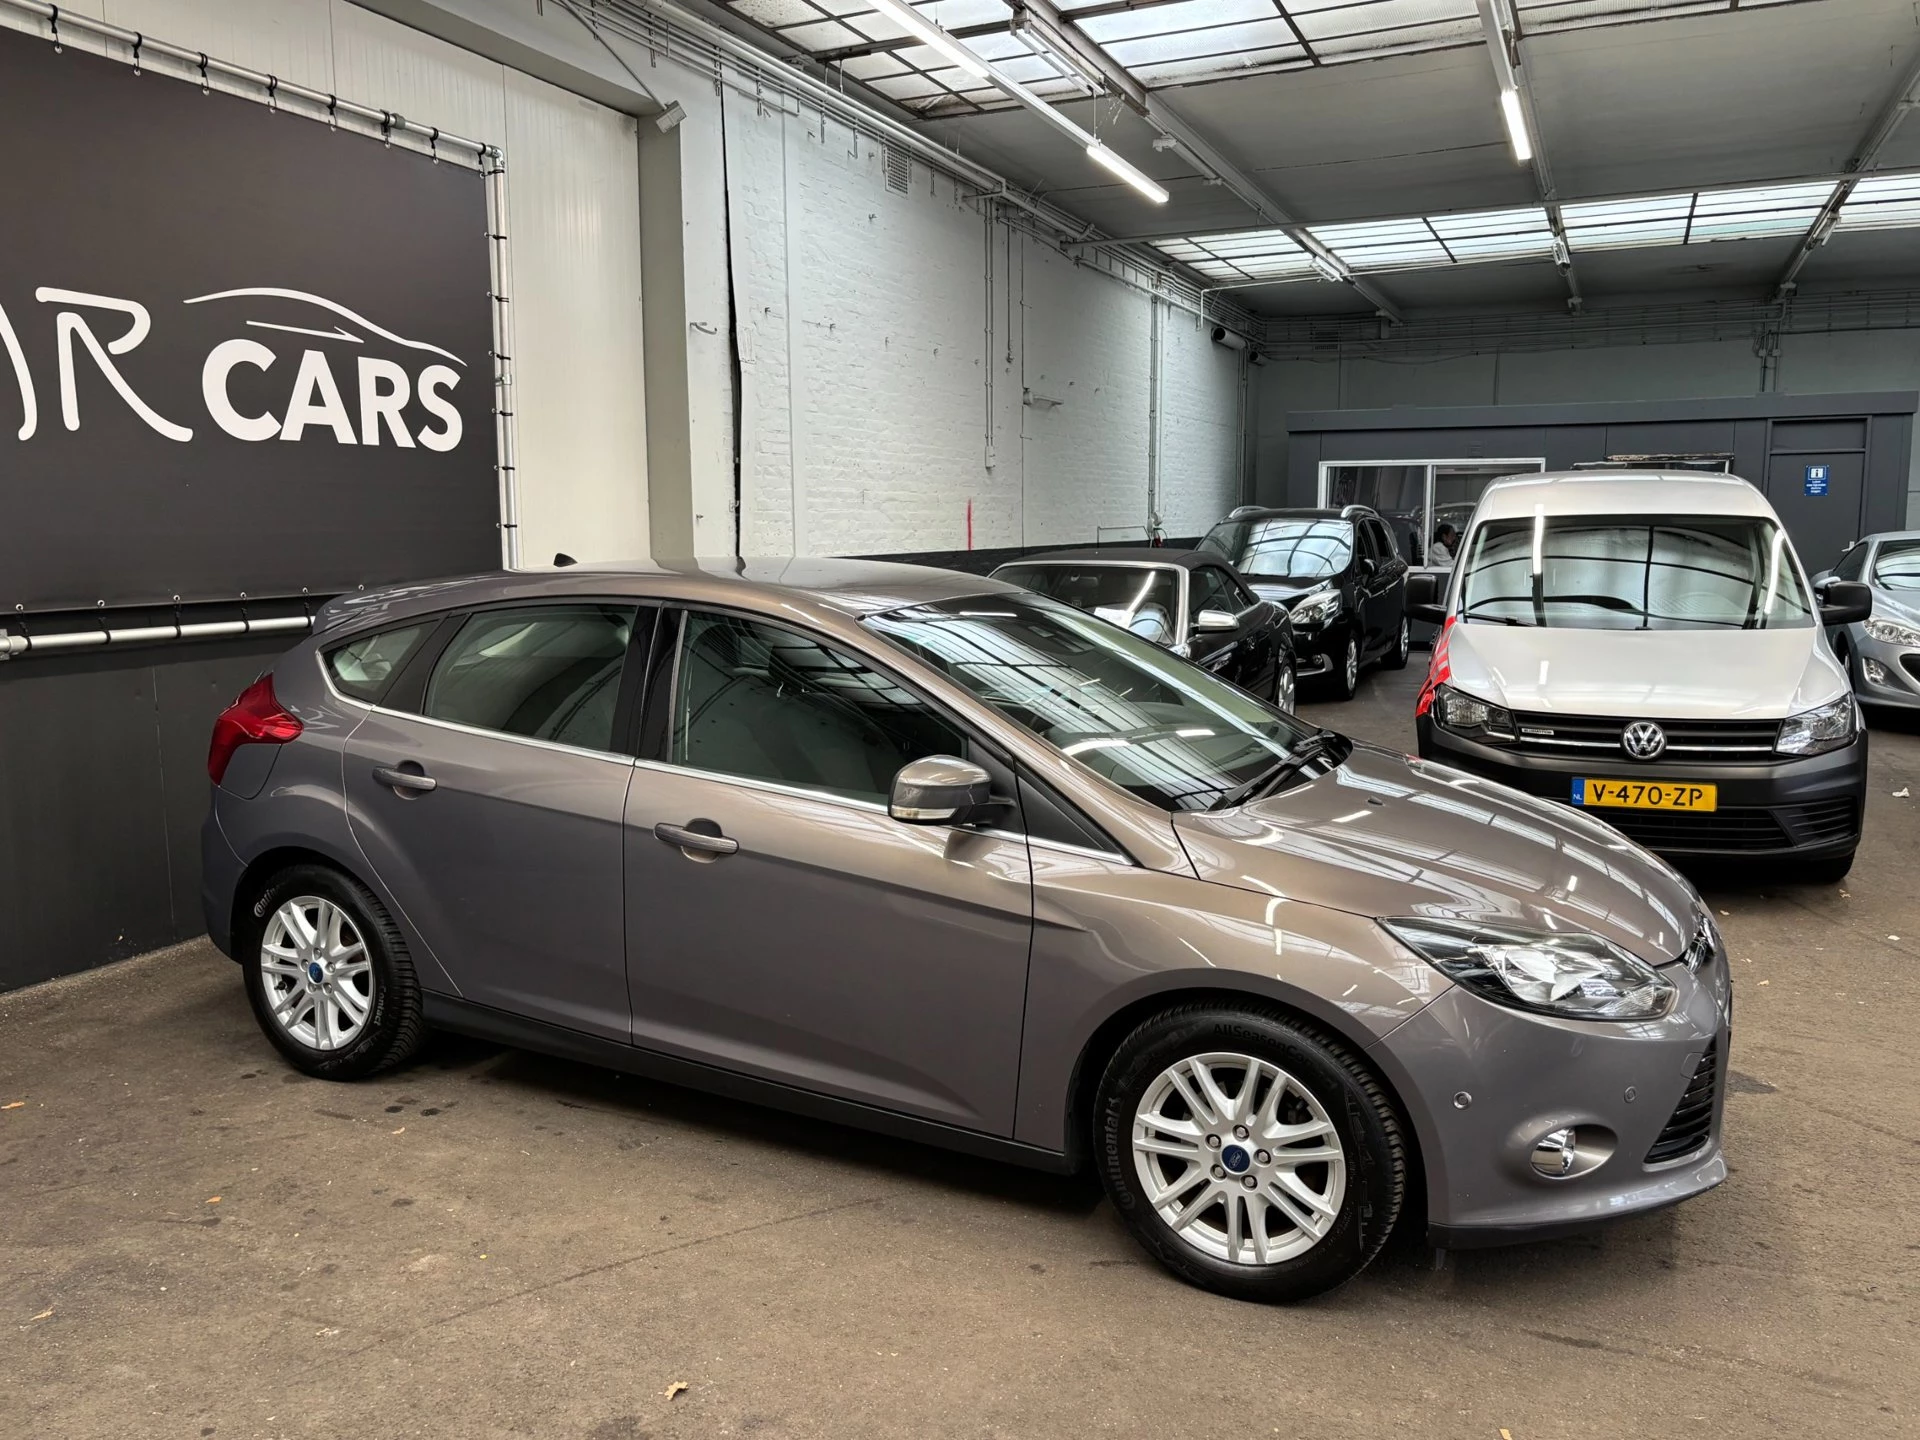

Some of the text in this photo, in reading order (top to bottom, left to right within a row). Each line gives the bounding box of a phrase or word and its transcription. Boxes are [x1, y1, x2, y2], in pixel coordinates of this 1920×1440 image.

[202, 339, 463, 452] CARS
[1573, 793, 1583, 801] NL
[1593, 784, 1703, 807] V-470-ZP
